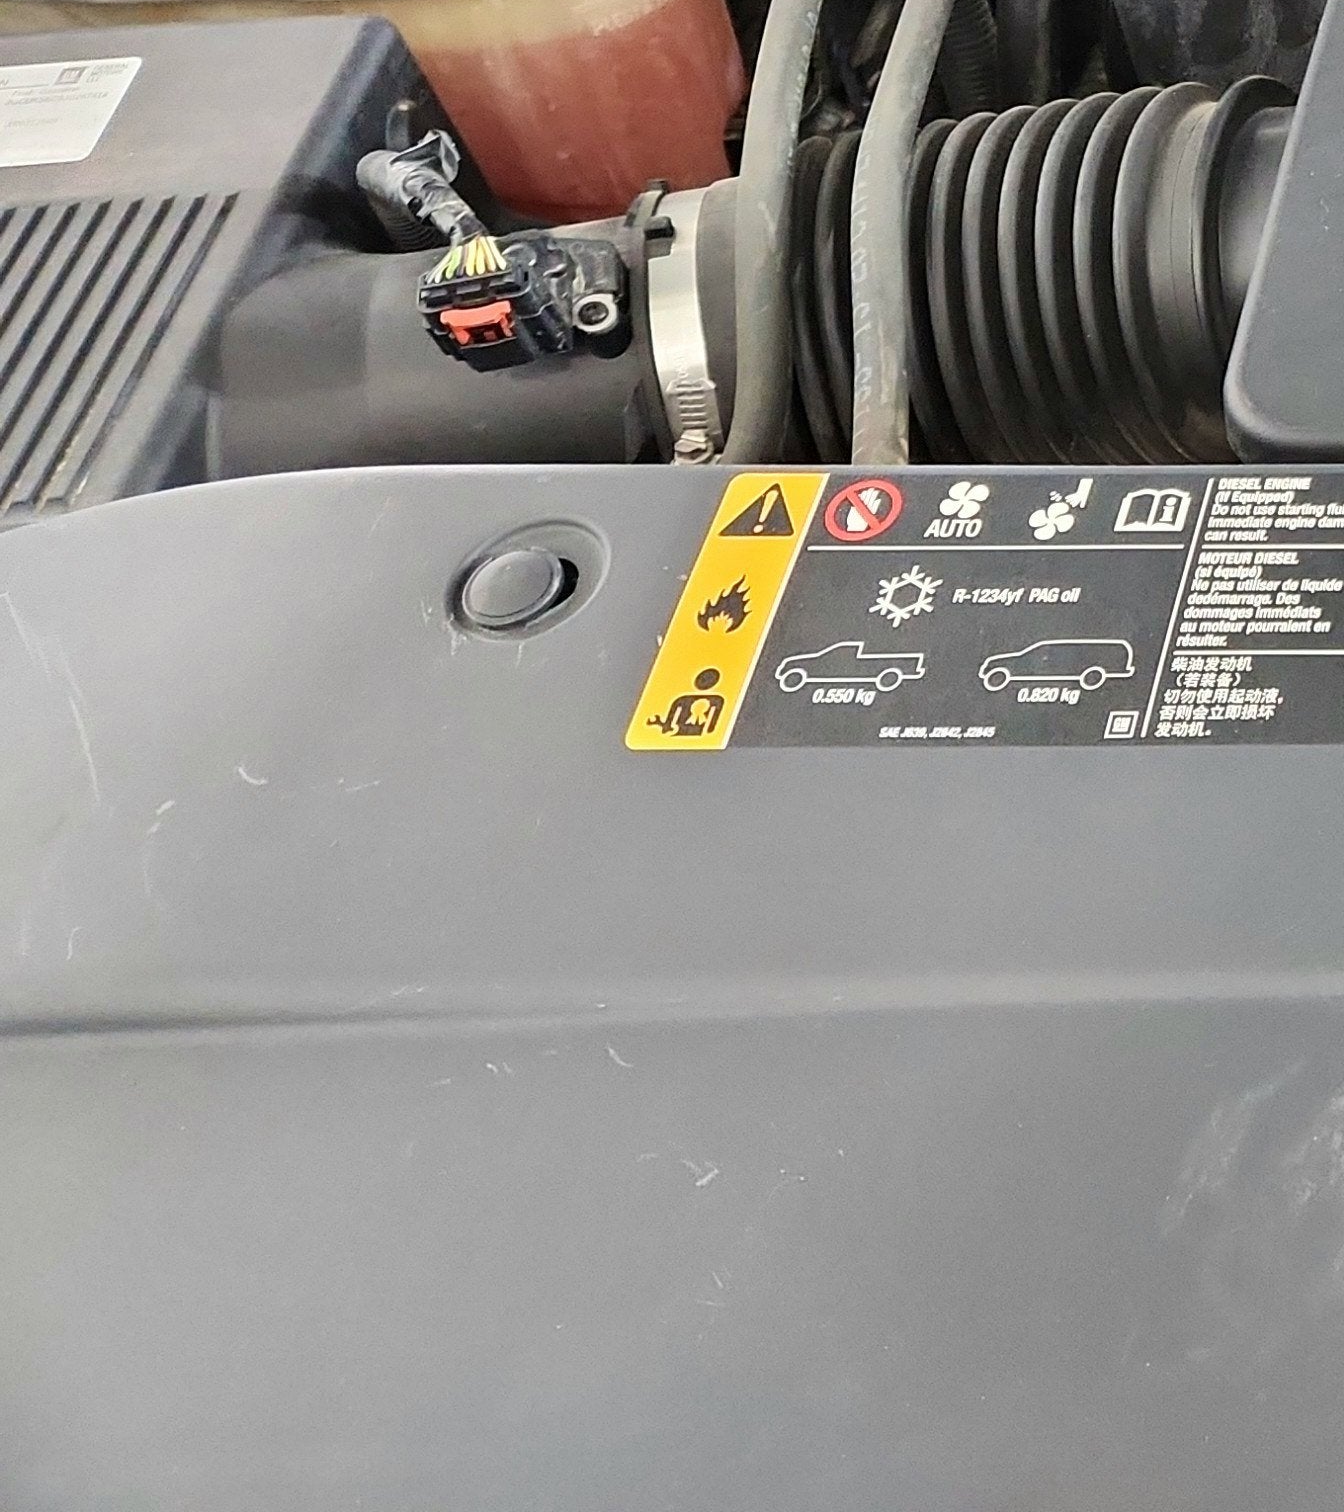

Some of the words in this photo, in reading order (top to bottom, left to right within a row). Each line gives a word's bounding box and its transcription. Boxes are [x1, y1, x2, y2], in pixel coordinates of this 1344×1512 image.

[1218, 477, 1261, 490] DIESEL
[1264, 477, 1312, 490] ENGINE
[1215, 491, 1231, 503] (If
[1231, 491, 1295, 504] Equipped)
[1211, 504, 1229, 515] Do
[1230, 504, 1251, 515] not
[1253, 506, 1276, 515] use
[1278, 504, 1325, 517] starting
[923, 519, 983, 538] AUTO
[1207, 517, 1273, 528] Immediate
[1274, 517, 1316, 530] engine
[1204, 532, 1228, 541] can
[1229, 530, 1269, 541] result.
[1198, 552, 1252, 565] MOTEUR
[1253, 552, 1299, 565] DIESEL
[1194, 566, 1212, 579] (si
[1213, 566, 1263, 580] équipé)
[1190, 579, 1210, 591] Ne
[1211, 582, 1234, 592] pas
[1236, 579, 1280, 591] utiliser
[1282, 579, 1299, 591] de
[1300, 579, 1344, 593] liquide
[952, 588, 1025, 606] R-1234yf
[1028, 588, 1060, 603] PAG
[1061, 587, 1081, 603] oil
[1275, 593, 1301, 605] Des
[1184, 606, 1253, 620] dommages
[1255, 606, 1322, 619] immédiats
[1180, 623, 1197, 633] au
[1199, 621, 1246, 633] moteur
[1246, 621, 1312, 635] pourraient
[1313, 622, 1331, 633] en
[1176, 634, 1228, 647] résulter.
[1171, 656, 1253, 672] 柴油发动机
[812, 689, 855, 703] 0.550
[855, 689, 876, 706] kg
[1017, 688, 1059, 702] 0.820
[1060, 688, 1081, 705] kg
[1159, 705, 1276, 720] 否则会立即损坏
[878, 726, 901, 738] SAE
